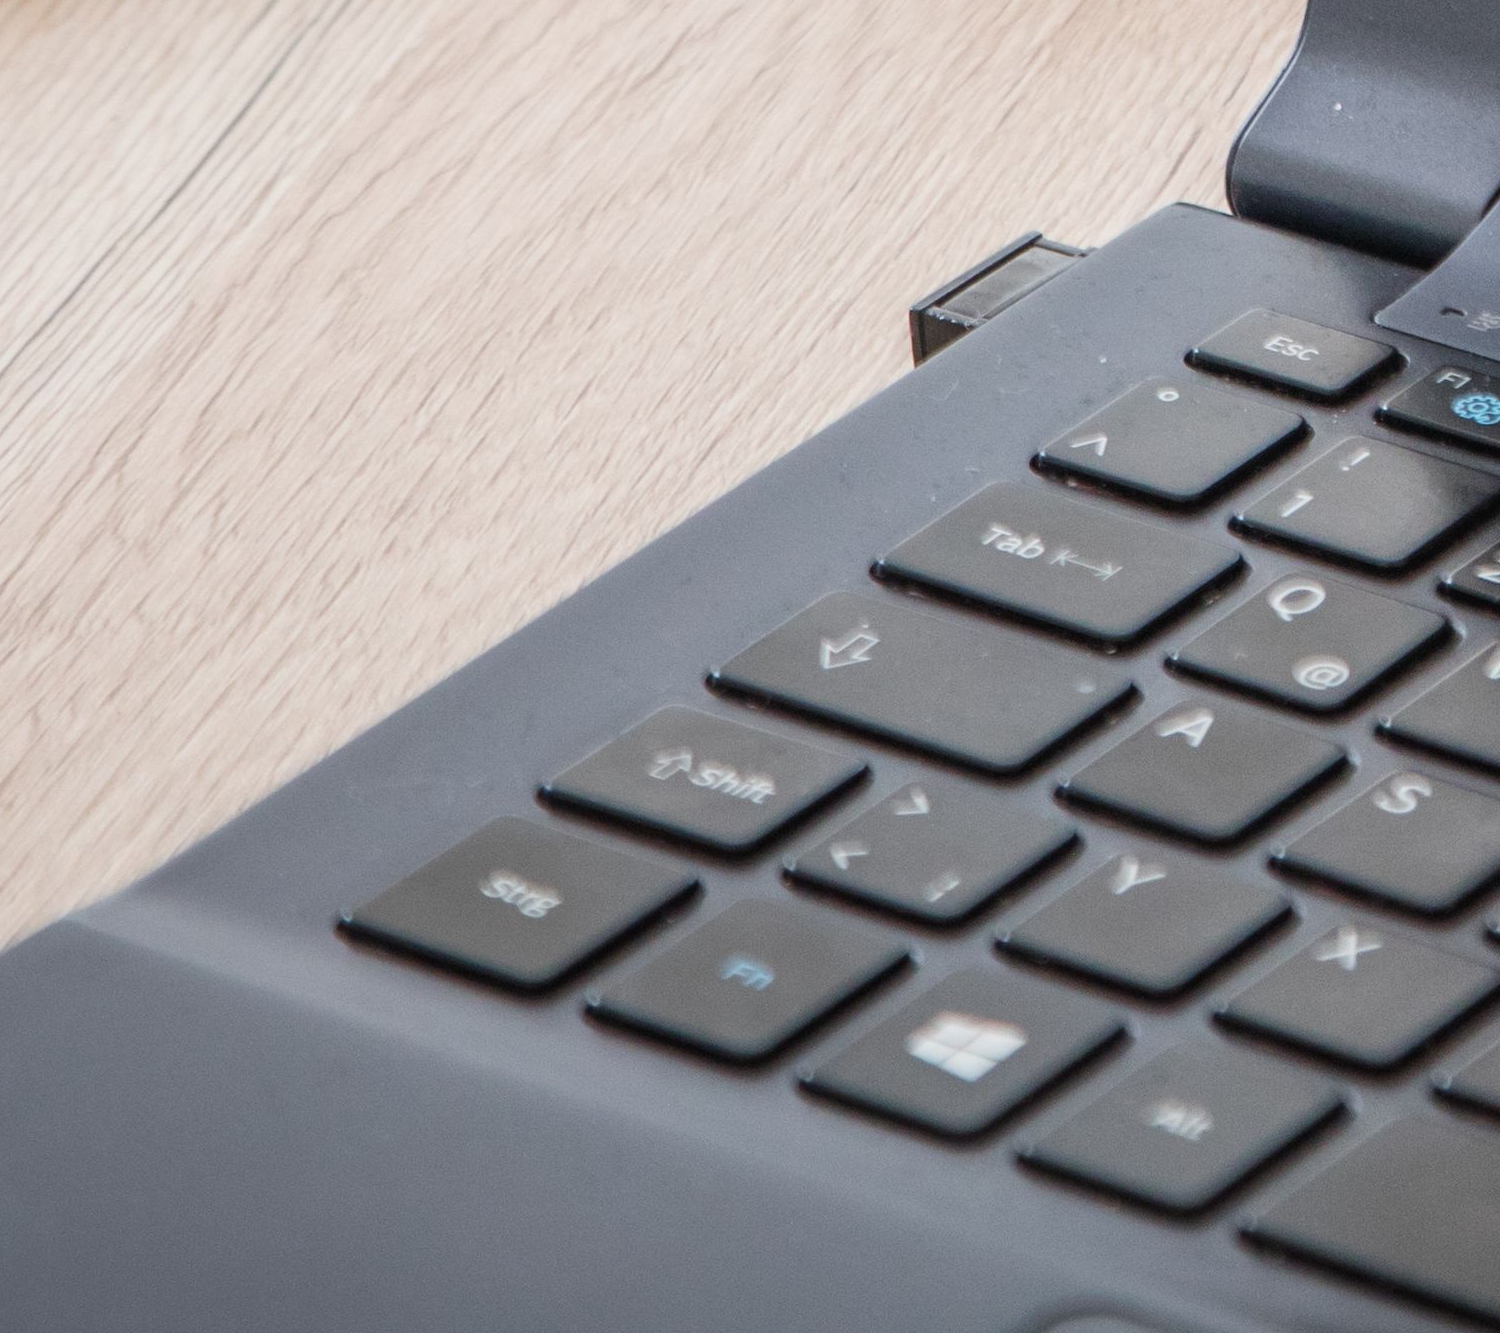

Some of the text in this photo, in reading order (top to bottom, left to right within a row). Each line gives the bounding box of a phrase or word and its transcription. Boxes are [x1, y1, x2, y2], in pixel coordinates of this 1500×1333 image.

[1263, 337, 1319, 364] Esc
[1437, 370, 1472, 389] F1
[1340, 448, 1371, 472] !
[1280, 494, 1313, 518] 1
[980, 523, 1045, 561] Tab
[1267, 579, 1326, 622] Q
[1293, 656, 1350, 691] @
[1157, 706, 1215, 748] A
[691, 767, 777, 804] Shift
[1372, 770, 1433, 814] S
[1114, 852, 1168, 896] Y
[479, 870, 564, 919] Strg
[1315, 924, 1383, 971] X
[720, 959, 773, 990] Fn
